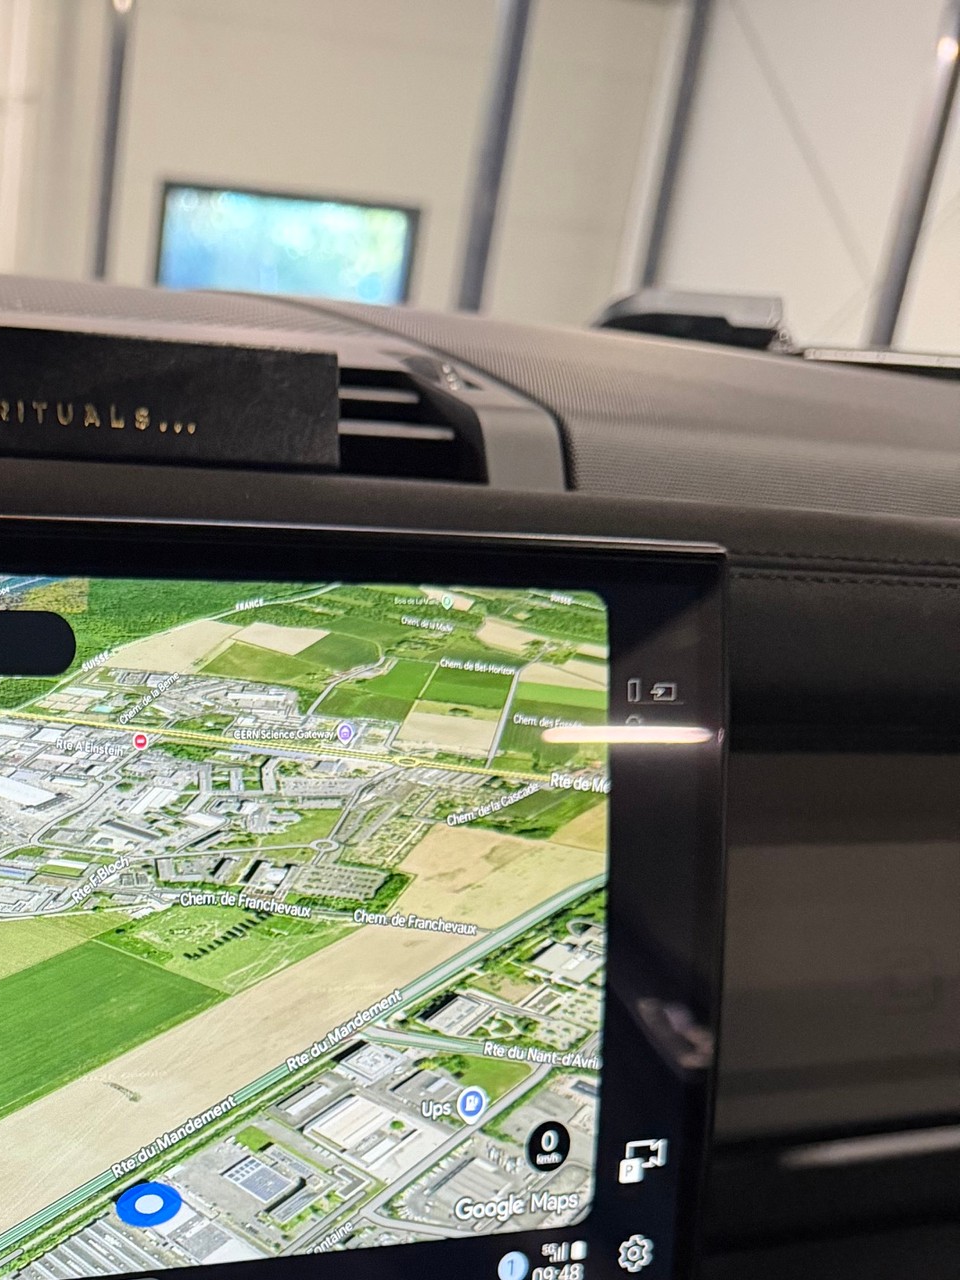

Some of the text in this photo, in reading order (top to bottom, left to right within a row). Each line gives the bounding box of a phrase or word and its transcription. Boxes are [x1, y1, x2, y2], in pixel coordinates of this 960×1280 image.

[233, 728, 334, 742] CERN Science Gateway
[97, 855, 130, 880] Bloch
[180, 892, 312, 918] Chem. de Franchevaux
[353, 909, 477, 936] Chem. de Franchevaux
[286, 988, 403, 1073] Rte du Mandement
[483, 1042, 505, 1057] Rte
[508, 1045, 525, 1061] du
[421, 1100, 452, 1121] Ups
[110, 1093, 238, 1179] Rte du Mandement
[541, 1129, 559, 1152] 0
[455, 1191, 580, 1221] Google Maps
